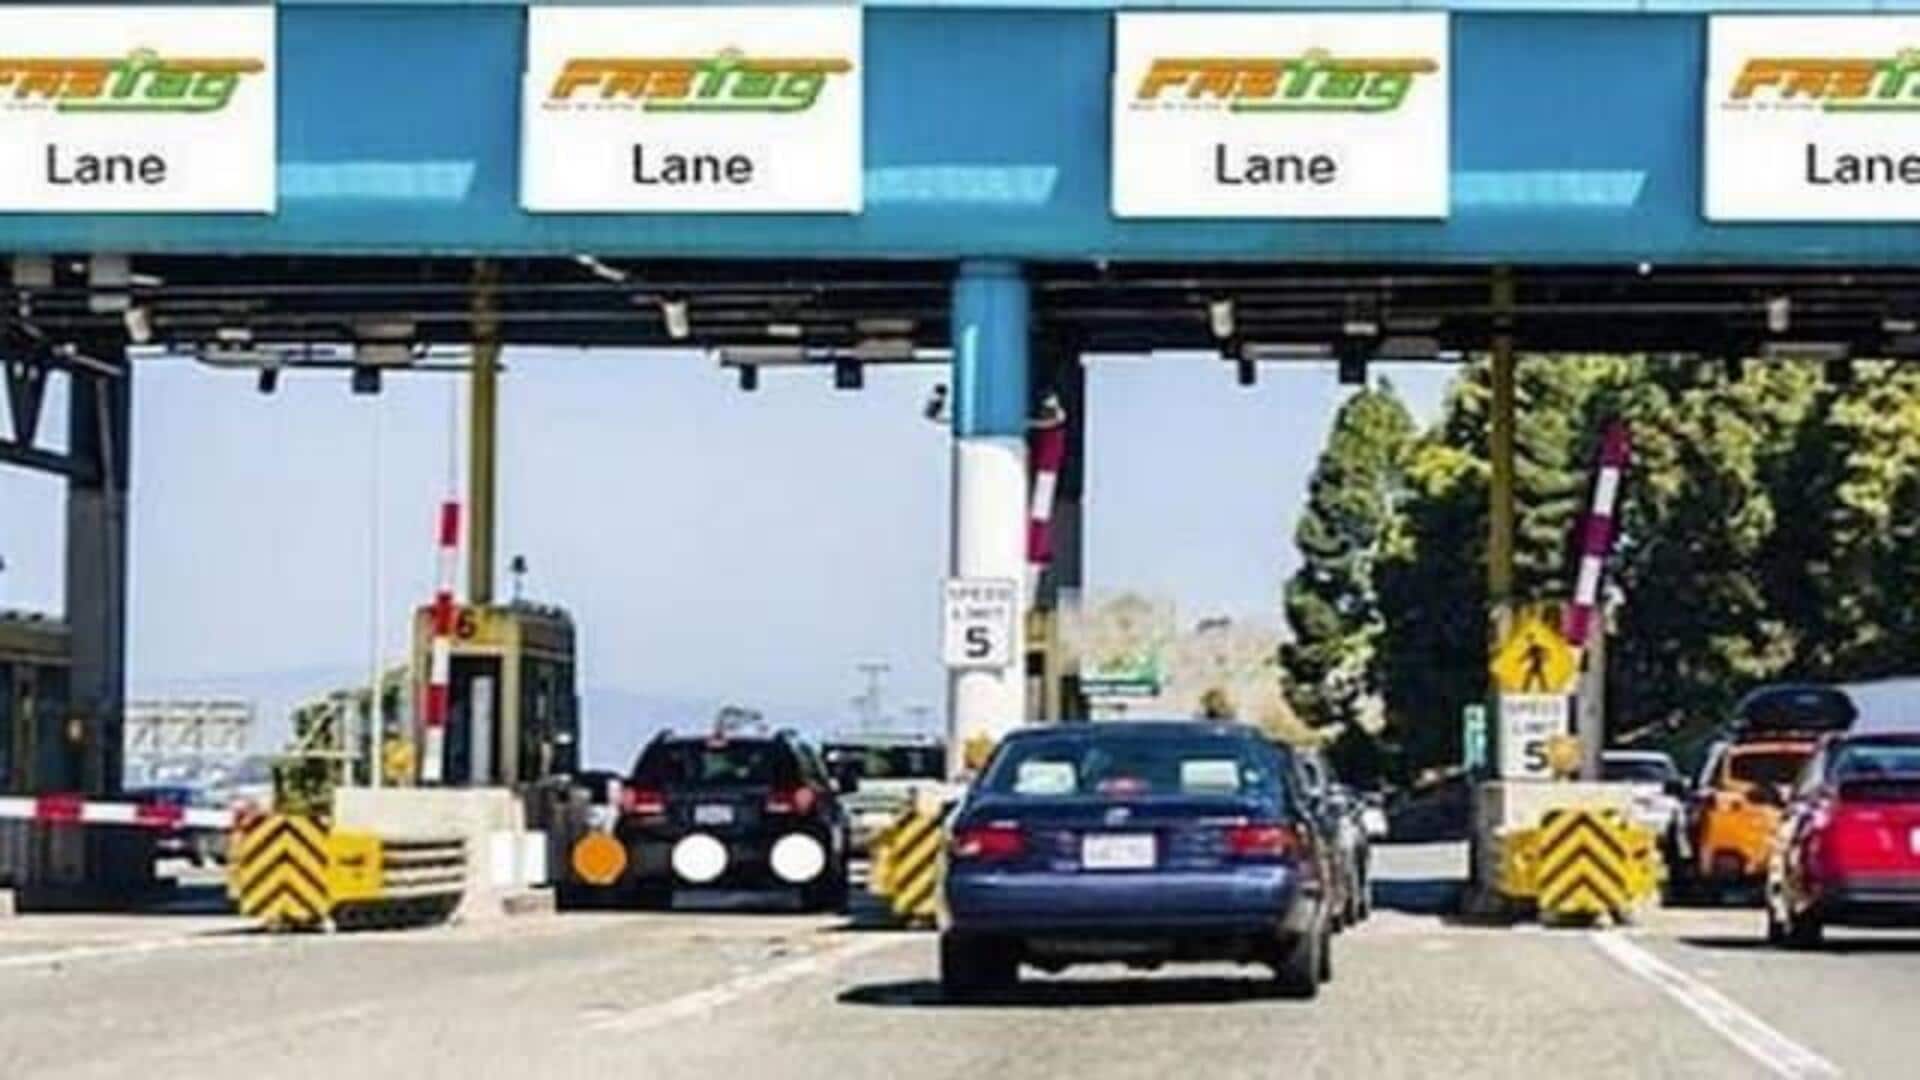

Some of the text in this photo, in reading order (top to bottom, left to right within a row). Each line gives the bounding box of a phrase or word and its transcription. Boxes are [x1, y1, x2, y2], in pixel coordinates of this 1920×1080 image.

[46, 144, 166, 184] Lane
[632, 143, 754, 185] Lane
[1215, 143, 1337, 185] Lane
[1805, 143, 1920, 185] Lane
[965, 625, 991, 658] 5
[1524, 740, 1550, 772] 5
